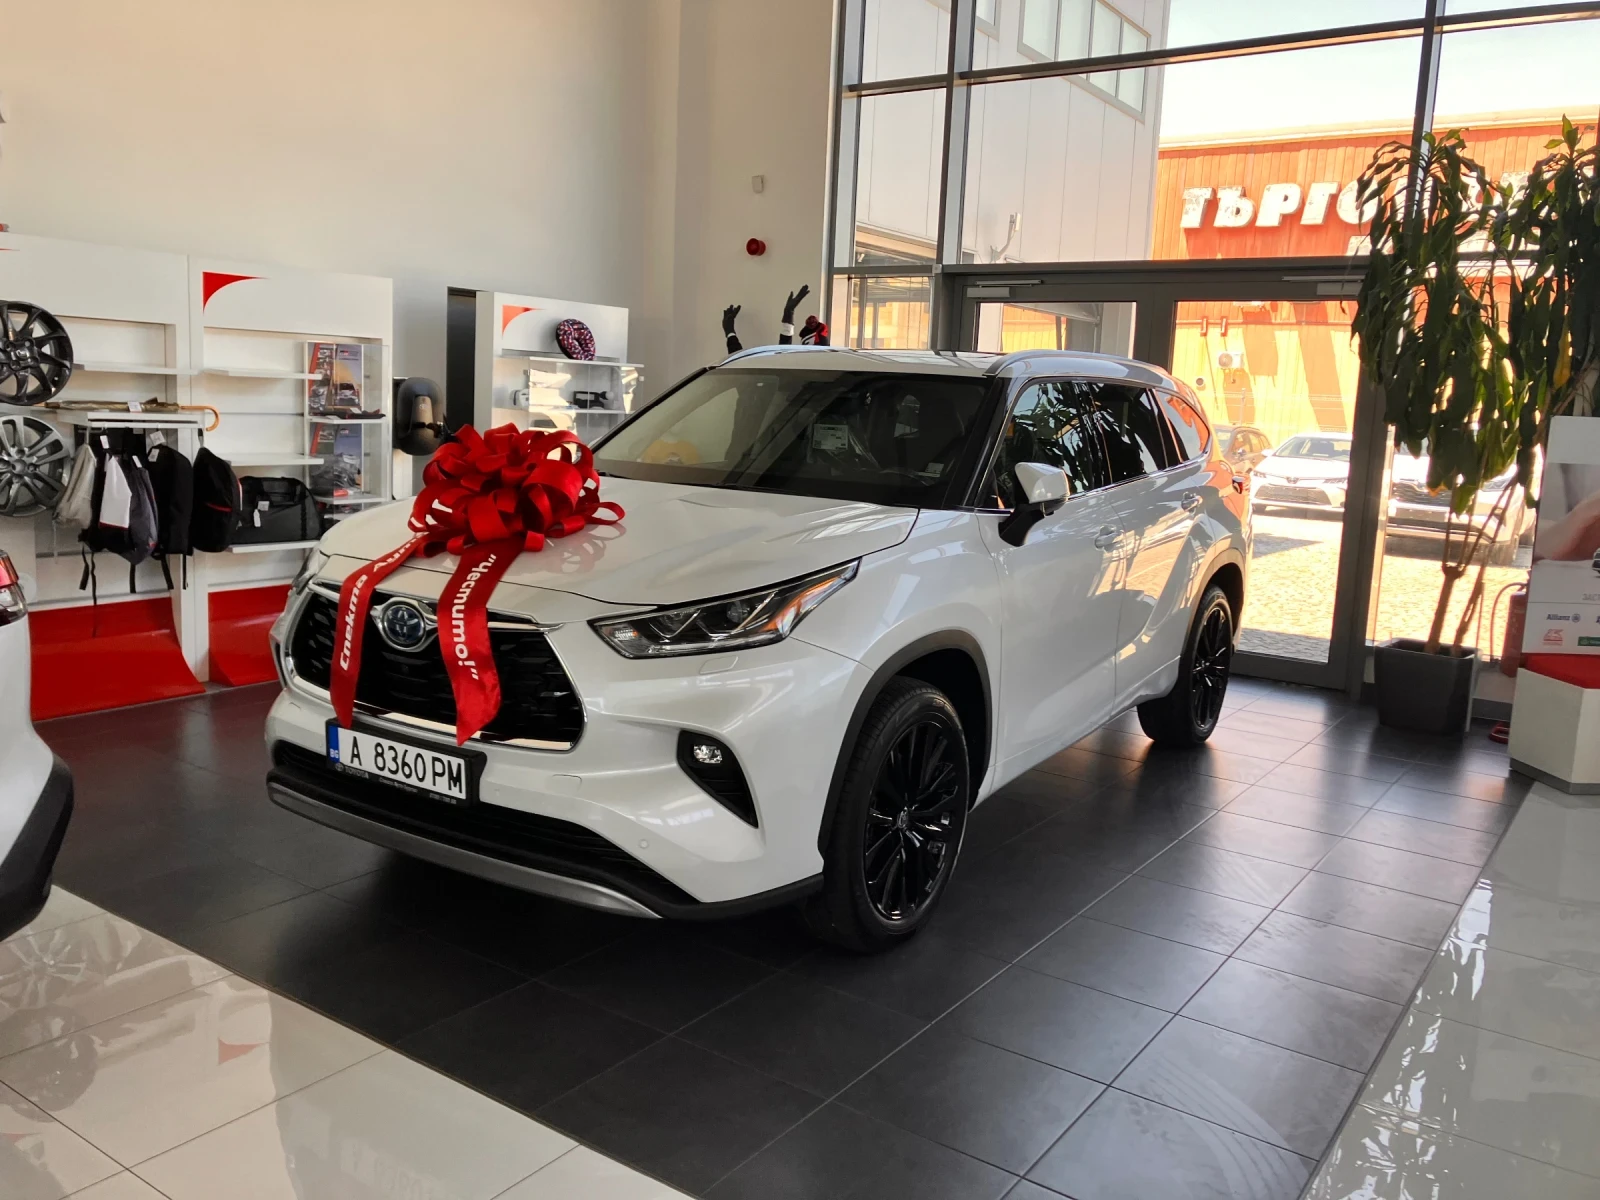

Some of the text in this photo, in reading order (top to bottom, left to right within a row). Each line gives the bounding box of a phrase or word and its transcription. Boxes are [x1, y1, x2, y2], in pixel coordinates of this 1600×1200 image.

[1546, 613, 1571, 621] Allianz
[329, 748, 339, 759] BG
[350, 735, 363, 767] A
[373, 742, 427, 783] 8360
[431, 755, 463, 794] PM
